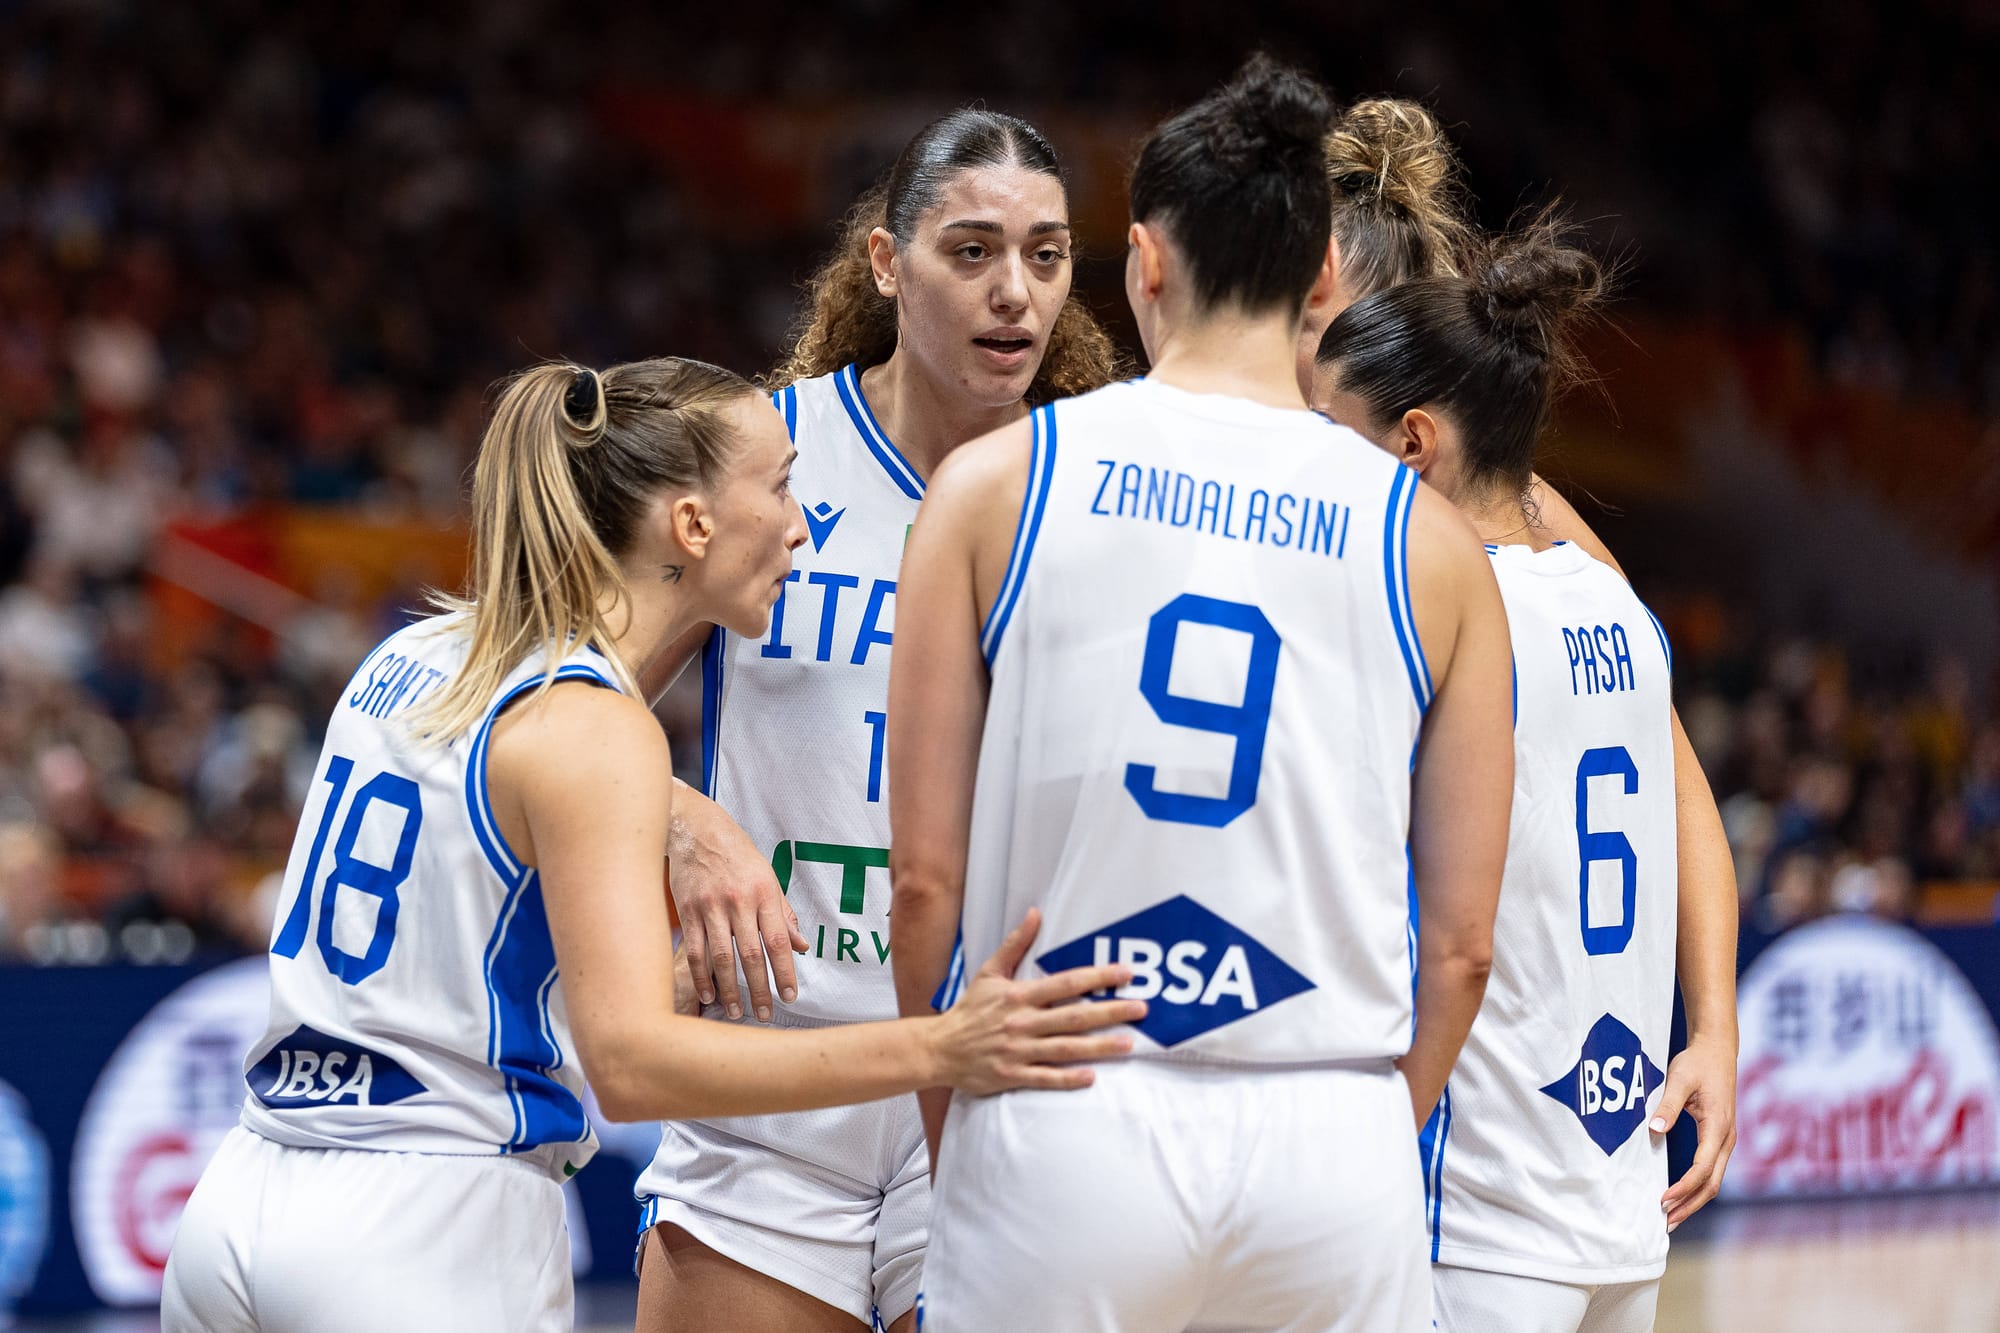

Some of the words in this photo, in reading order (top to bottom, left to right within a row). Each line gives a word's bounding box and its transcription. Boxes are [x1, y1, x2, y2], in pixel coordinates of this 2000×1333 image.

[1090, 460, 1350, 559] ZANDALASINI
[350, 652, 448, 719] SANT
[1562, 622, 1635, 695] PASA
[1123, 592, 1282, 829] 9
[271, 754, 423, 986] 18
[1576, 745, 1639, 956] 6
[1092, 936, 1258, 1010] IBSA
[263, 1049, 374, 1106] IBSA
[1579, 1054, 1646, 1116] IBSA
